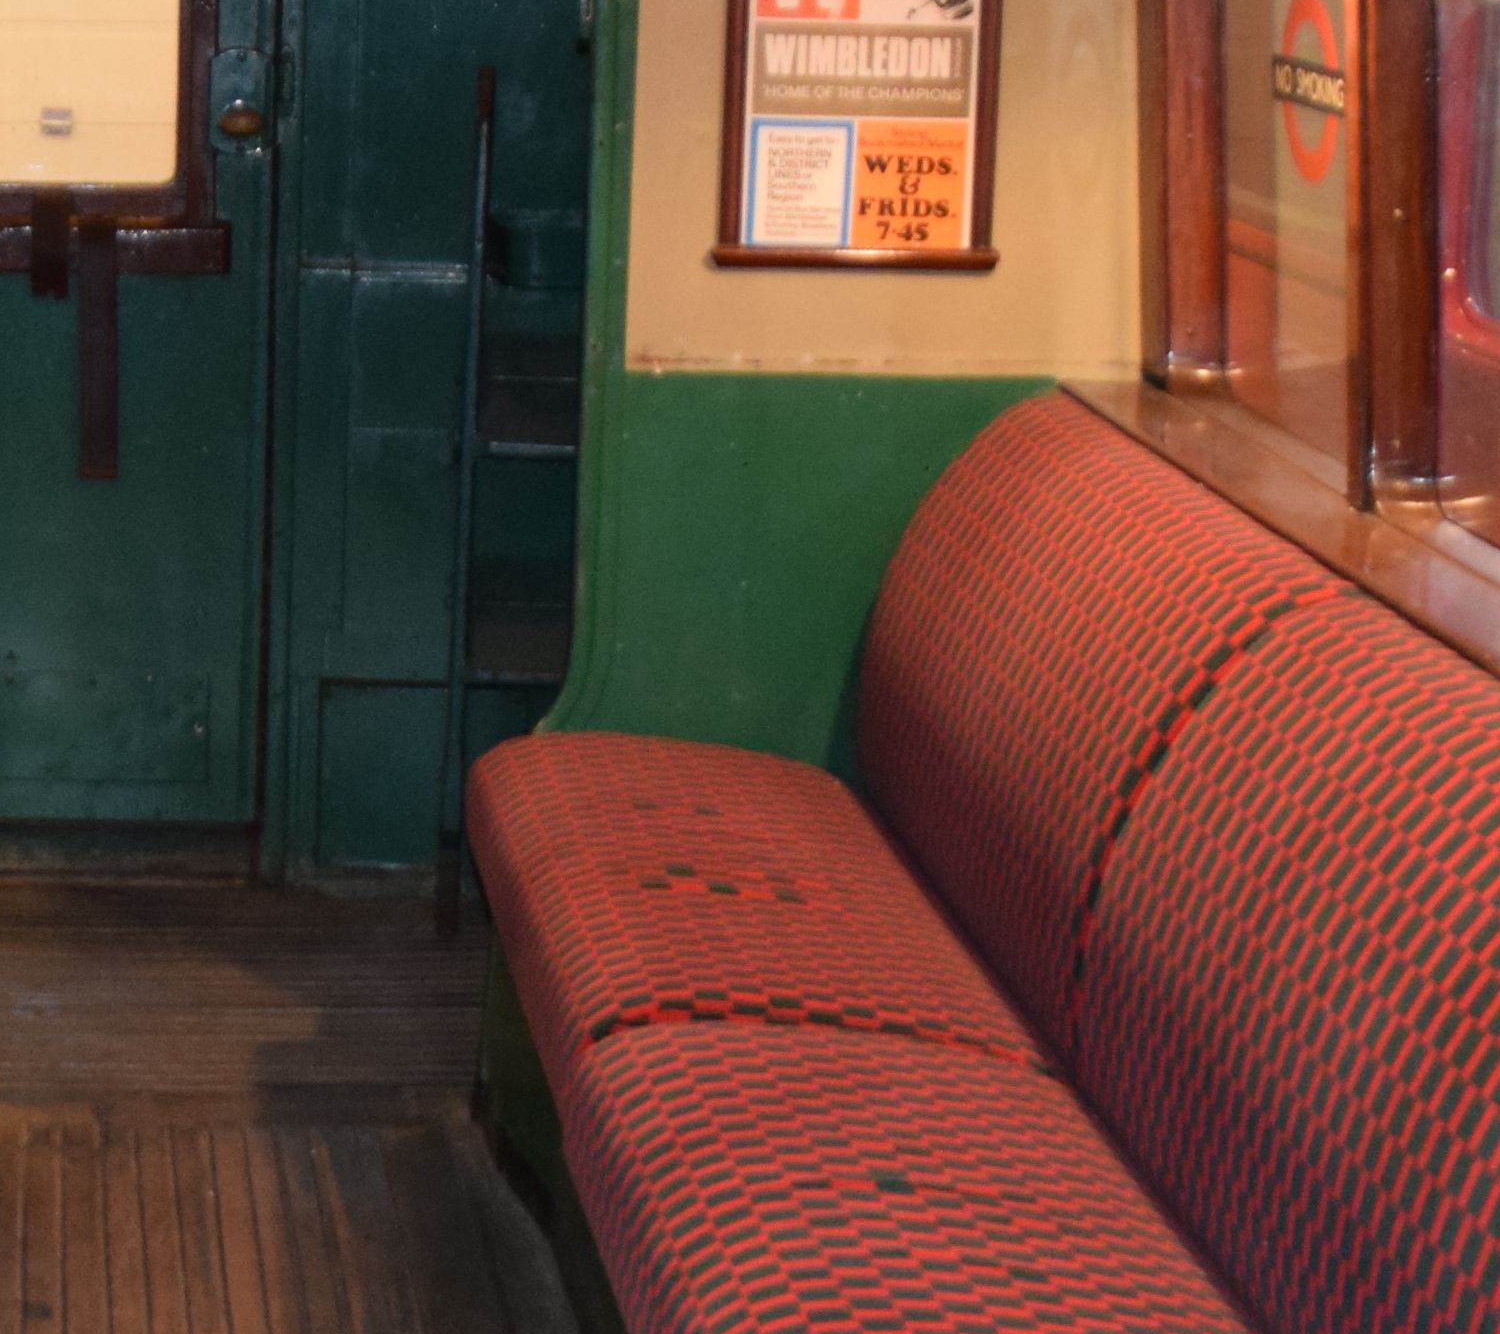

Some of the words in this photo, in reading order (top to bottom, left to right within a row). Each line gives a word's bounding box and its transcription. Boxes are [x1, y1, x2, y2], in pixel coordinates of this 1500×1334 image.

[764, 33, 952, 79] WIMBLEDON
[1275, 64, 1292, 93] NO
[813, 85, 832, 98] OF
[838, 85, 864, 99] THE
[768, 146, 832, 157] NORTHERN
[863, 154, 958, 175] WEDS.
[899, 175, 921, 195] &
[858, 198, 956, 218] FRIDS.
